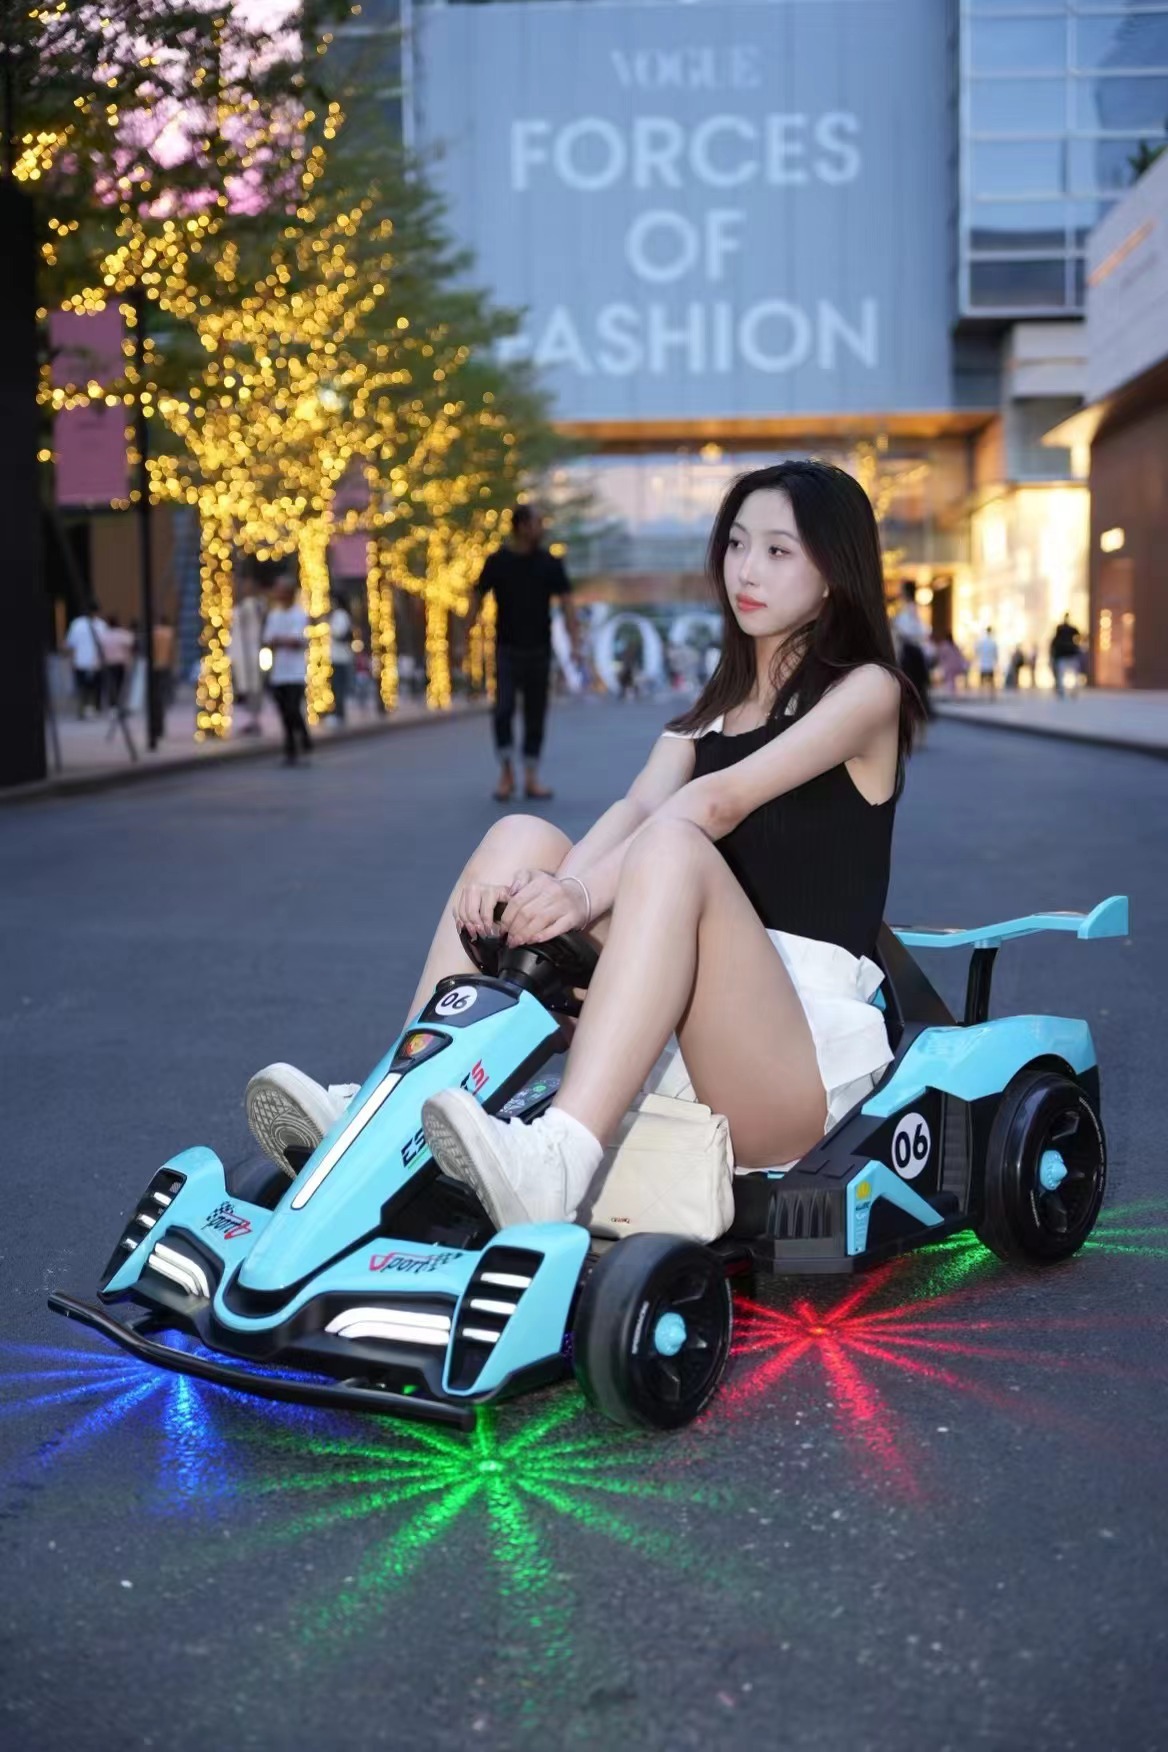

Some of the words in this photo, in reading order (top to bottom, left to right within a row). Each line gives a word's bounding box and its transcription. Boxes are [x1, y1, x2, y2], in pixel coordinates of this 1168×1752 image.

[611, 45, 761, 88] VOGUE
[511, 112, 861, 190] FORCES
[626, 210, 746, 281] OF
[441, 992, 471, 1010] 06
[895, 1123, 928, 1168] 06
